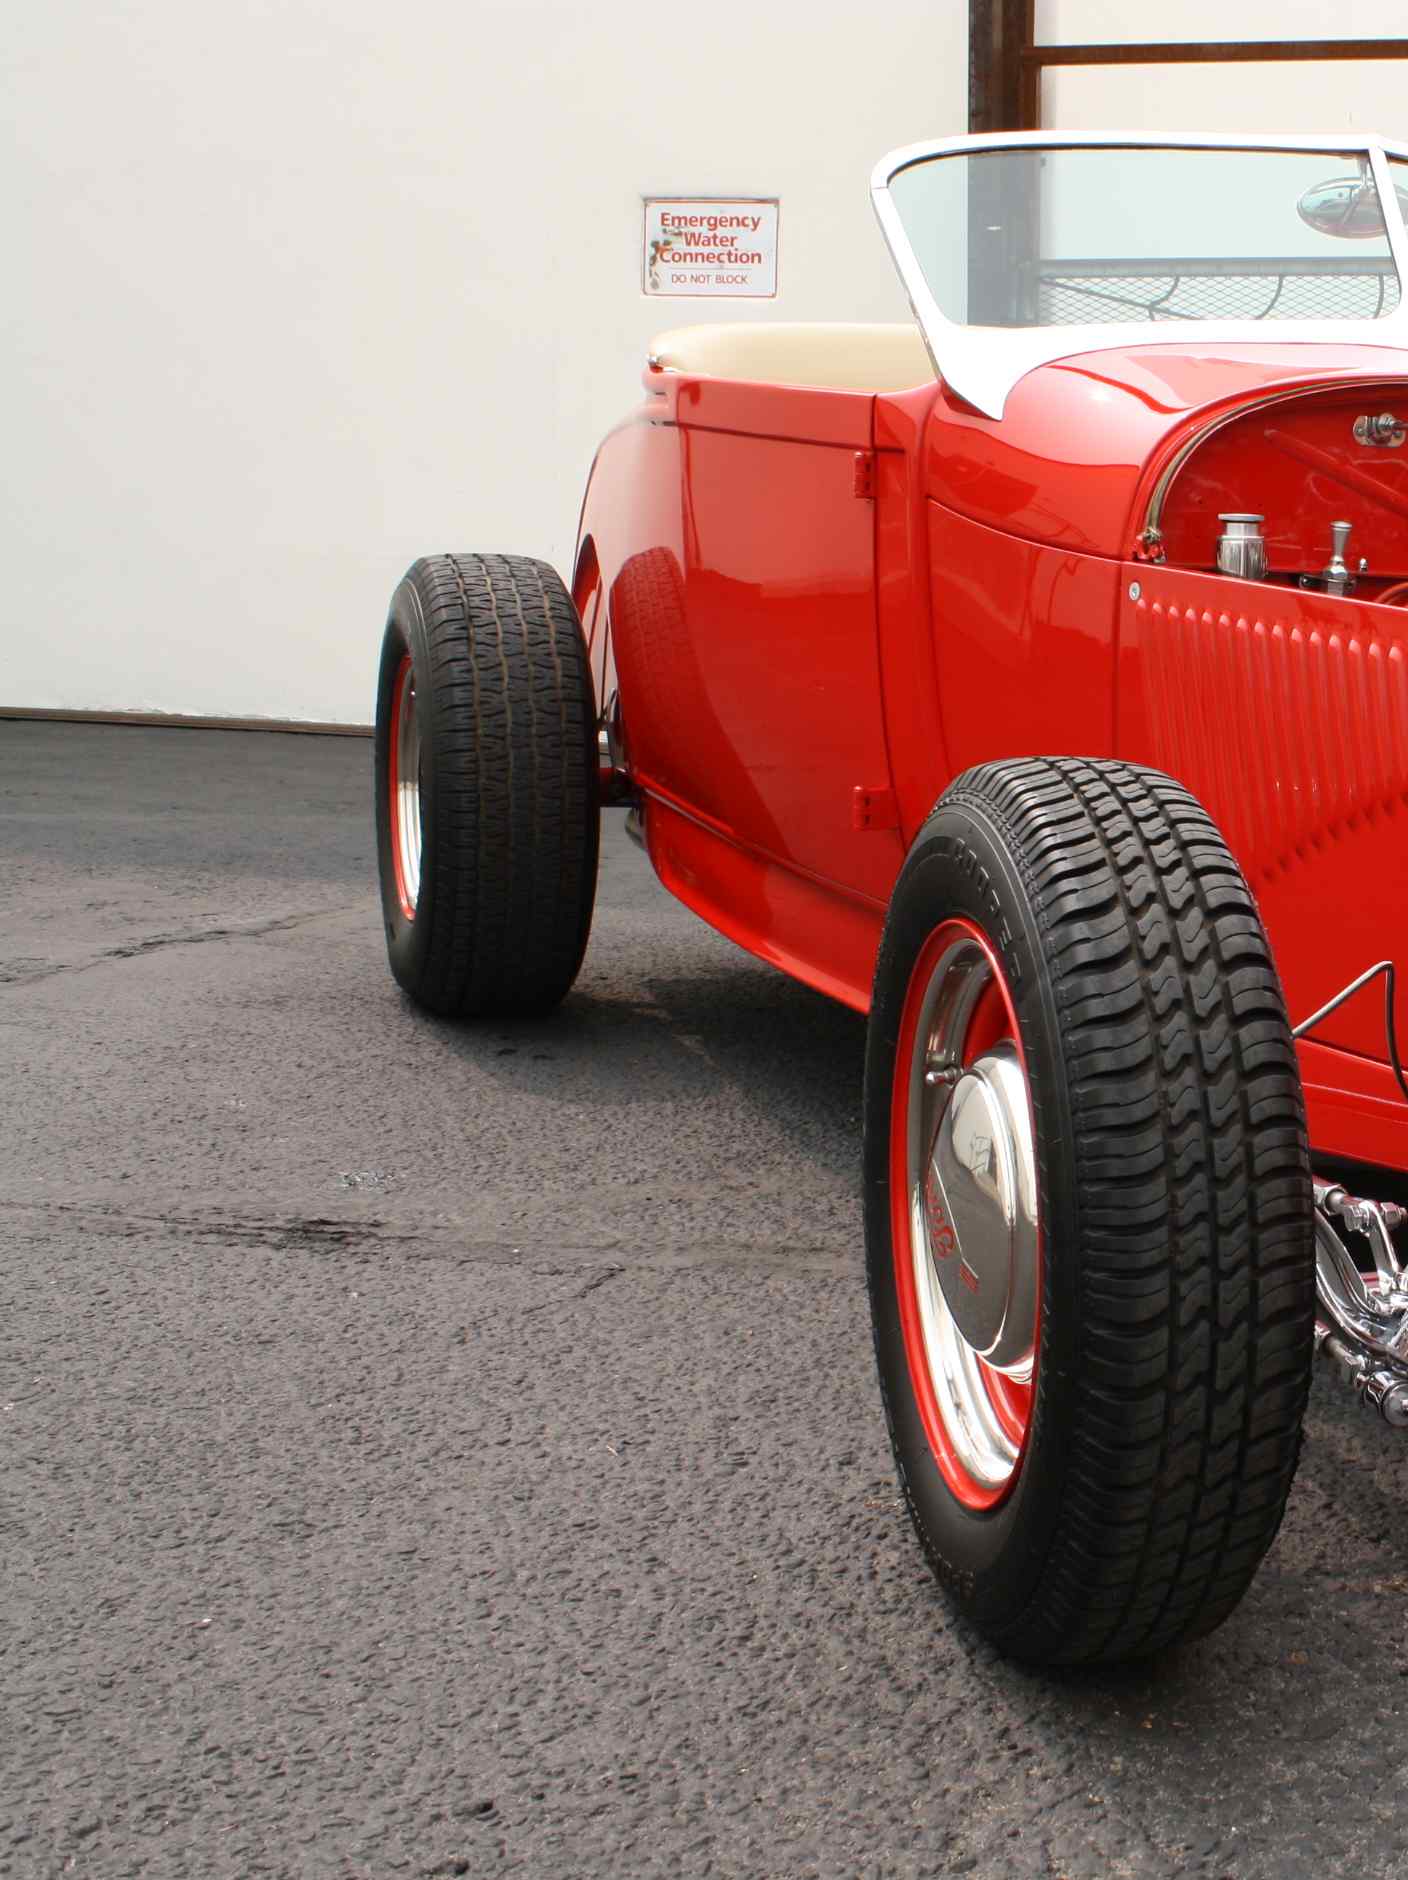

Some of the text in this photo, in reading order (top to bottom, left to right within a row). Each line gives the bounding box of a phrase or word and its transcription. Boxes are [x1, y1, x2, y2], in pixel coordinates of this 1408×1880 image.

[660, 212, 761, 231] Emergency
[684, 232, 738, 247] Water
[659, 249, 762, 264] Connection
[671, 274, 748, 284] DO NOT BLOCK
